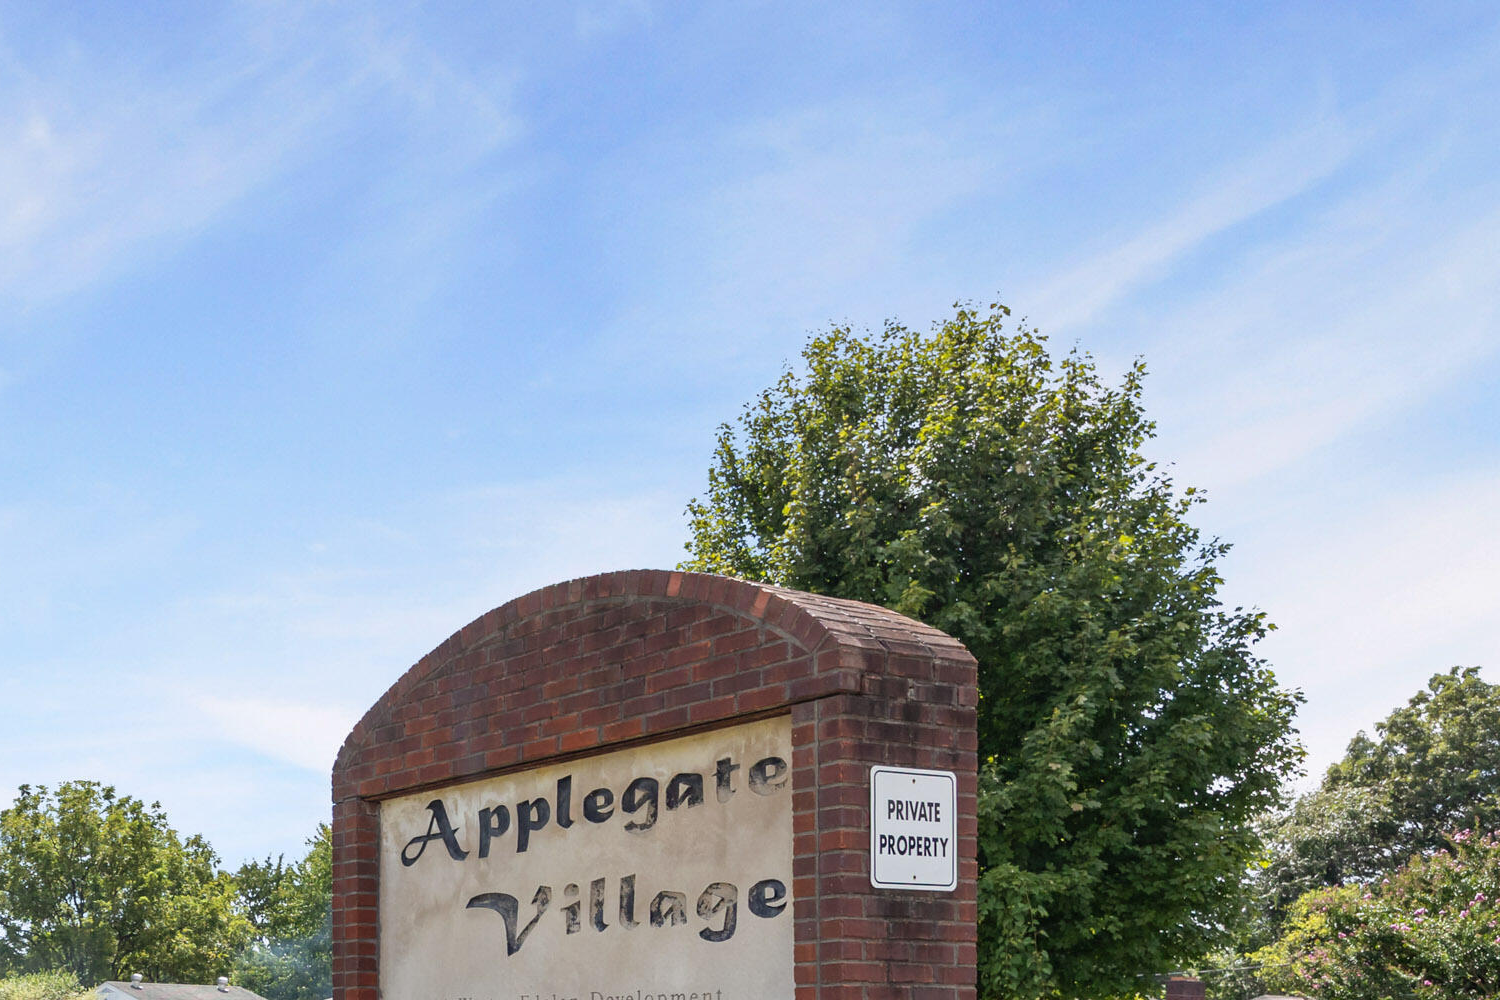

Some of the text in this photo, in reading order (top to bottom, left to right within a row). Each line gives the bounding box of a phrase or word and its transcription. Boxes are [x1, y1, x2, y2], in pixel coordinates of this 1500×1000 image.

[401, 756, 788, 867] Applegate
[887, 799, 941, 822] PRIVATE
[879, 834, 949, 858] PROPERTY
[466, 874, 788, 957] Village
